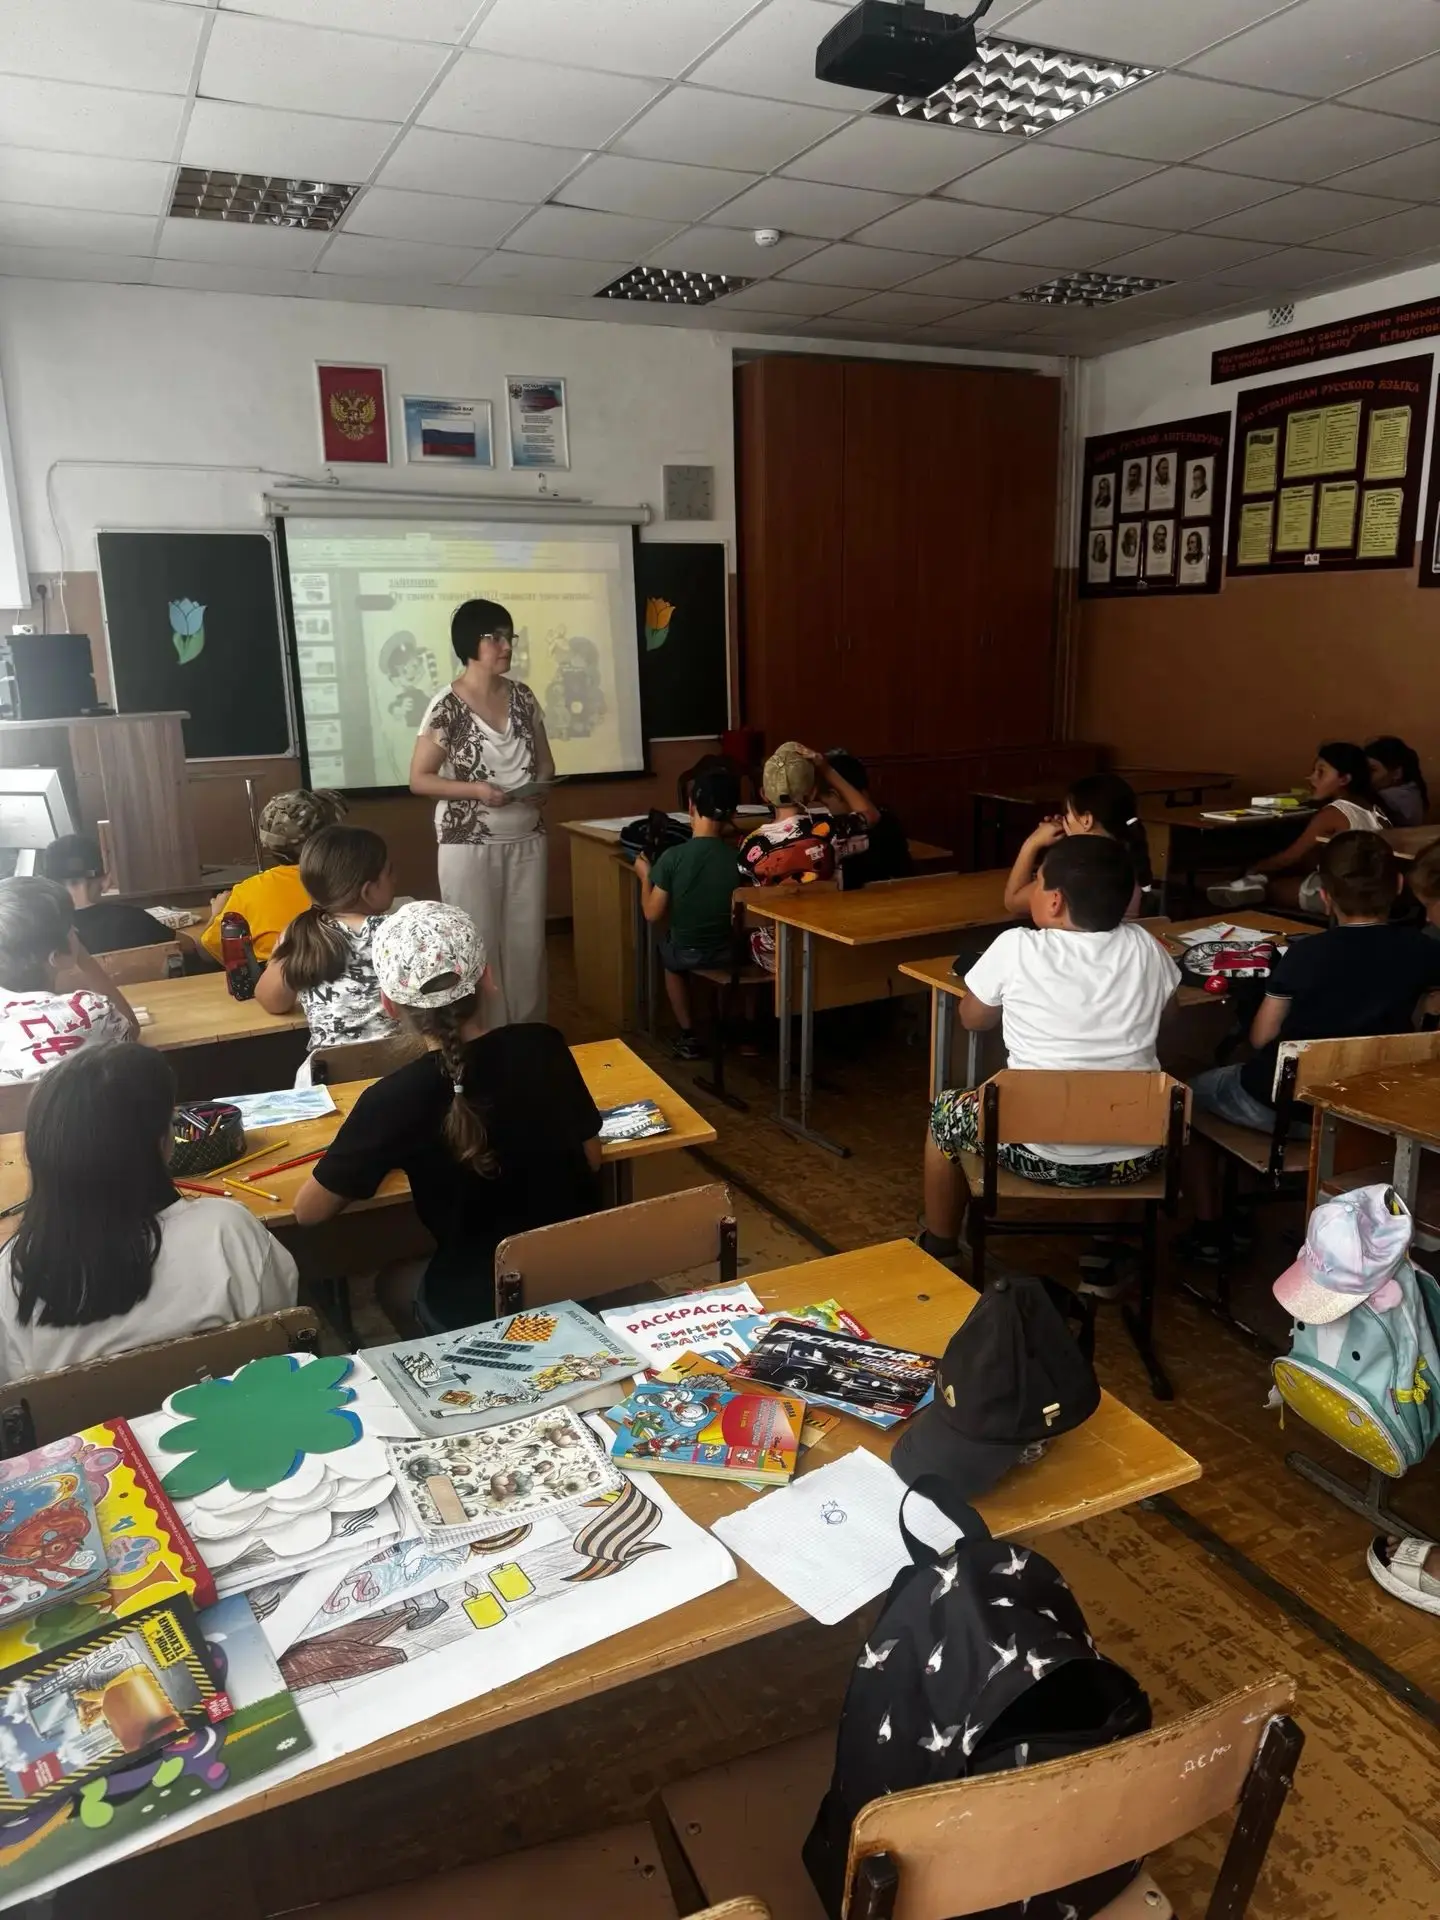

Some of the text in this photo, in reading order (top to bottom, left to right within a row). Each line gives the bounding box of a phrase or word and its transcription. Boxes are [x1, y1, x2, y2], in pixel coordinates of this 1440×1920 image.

[1321, 380, 1375, 396] РУССКОГО
[1378, 379, 1420, 393] ЯЗЫКА
[626, 1303, 749, 1334] РАСКРАСКА
[657, 1318, 731, 1340] СИНИЙ
[477, 1341, 531, 1353] СВЕРХУ
[650, 1328, 733, 1351] ТРАКТО
[771, 1327, 922, 1364] РАСКРАСКА
[154, 1635, 177, 1662] СТРОЙ
[157, 1615, 186, 1657] ТЕХНИКА
